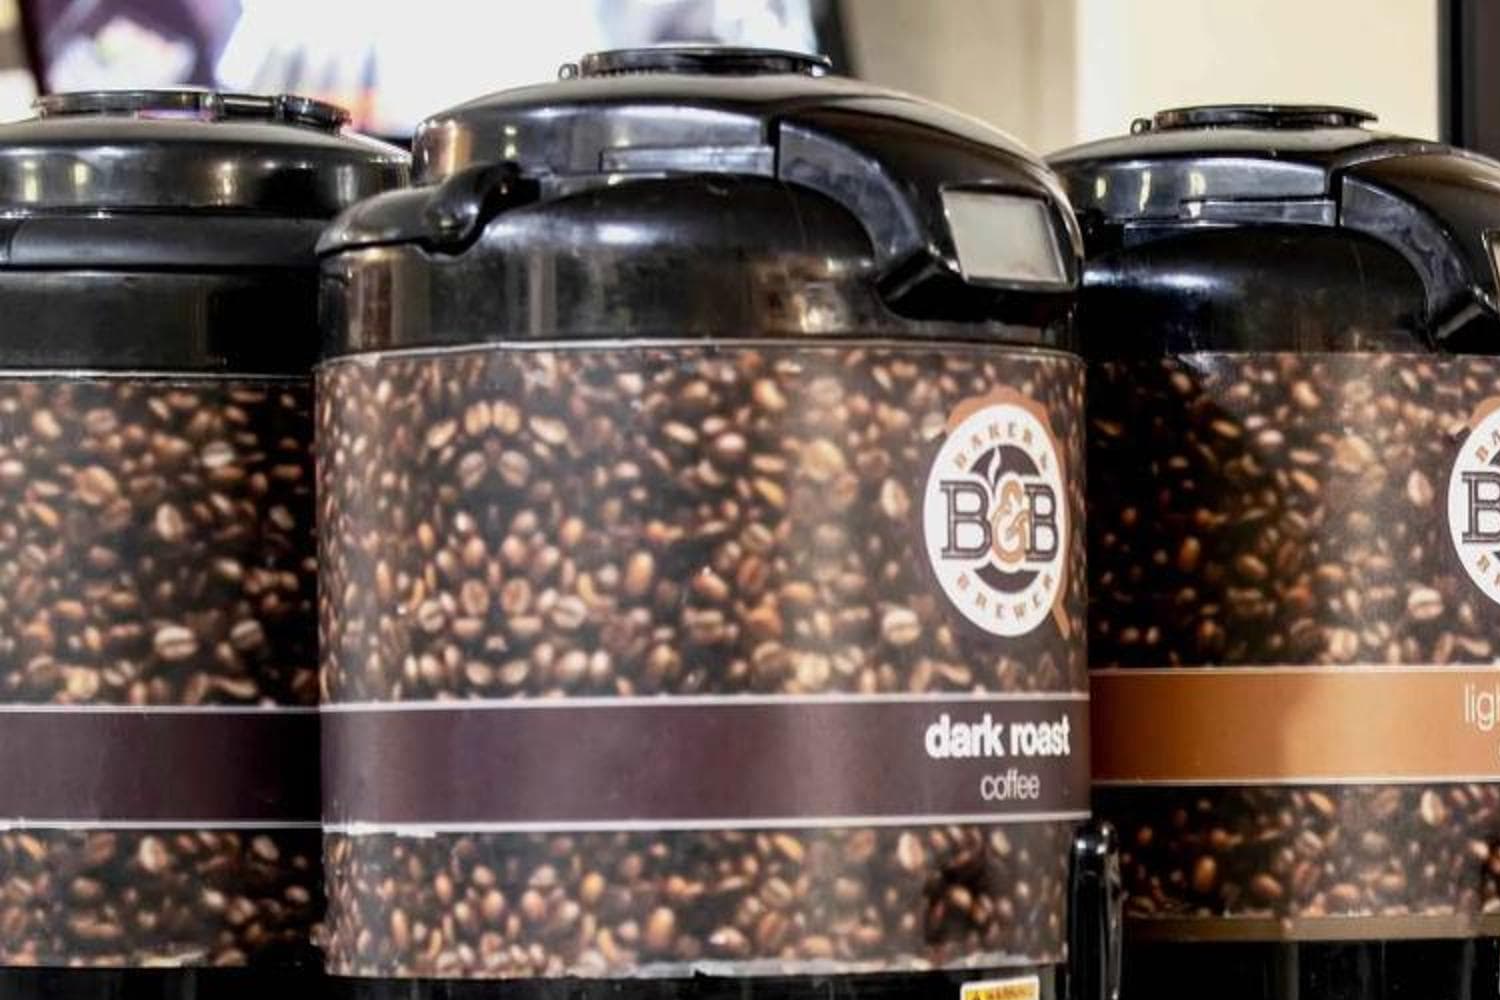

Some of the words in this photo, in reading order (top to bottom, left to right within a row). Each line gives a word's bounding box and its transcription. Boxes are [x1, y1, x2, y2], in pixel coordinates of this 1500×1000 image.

[939, 478, 1060, 565] B&B
[925, 713, 1005, 758] dark
[1010, 713, 1071, 756] roast
[980, 768, 1040, 800] coffee
